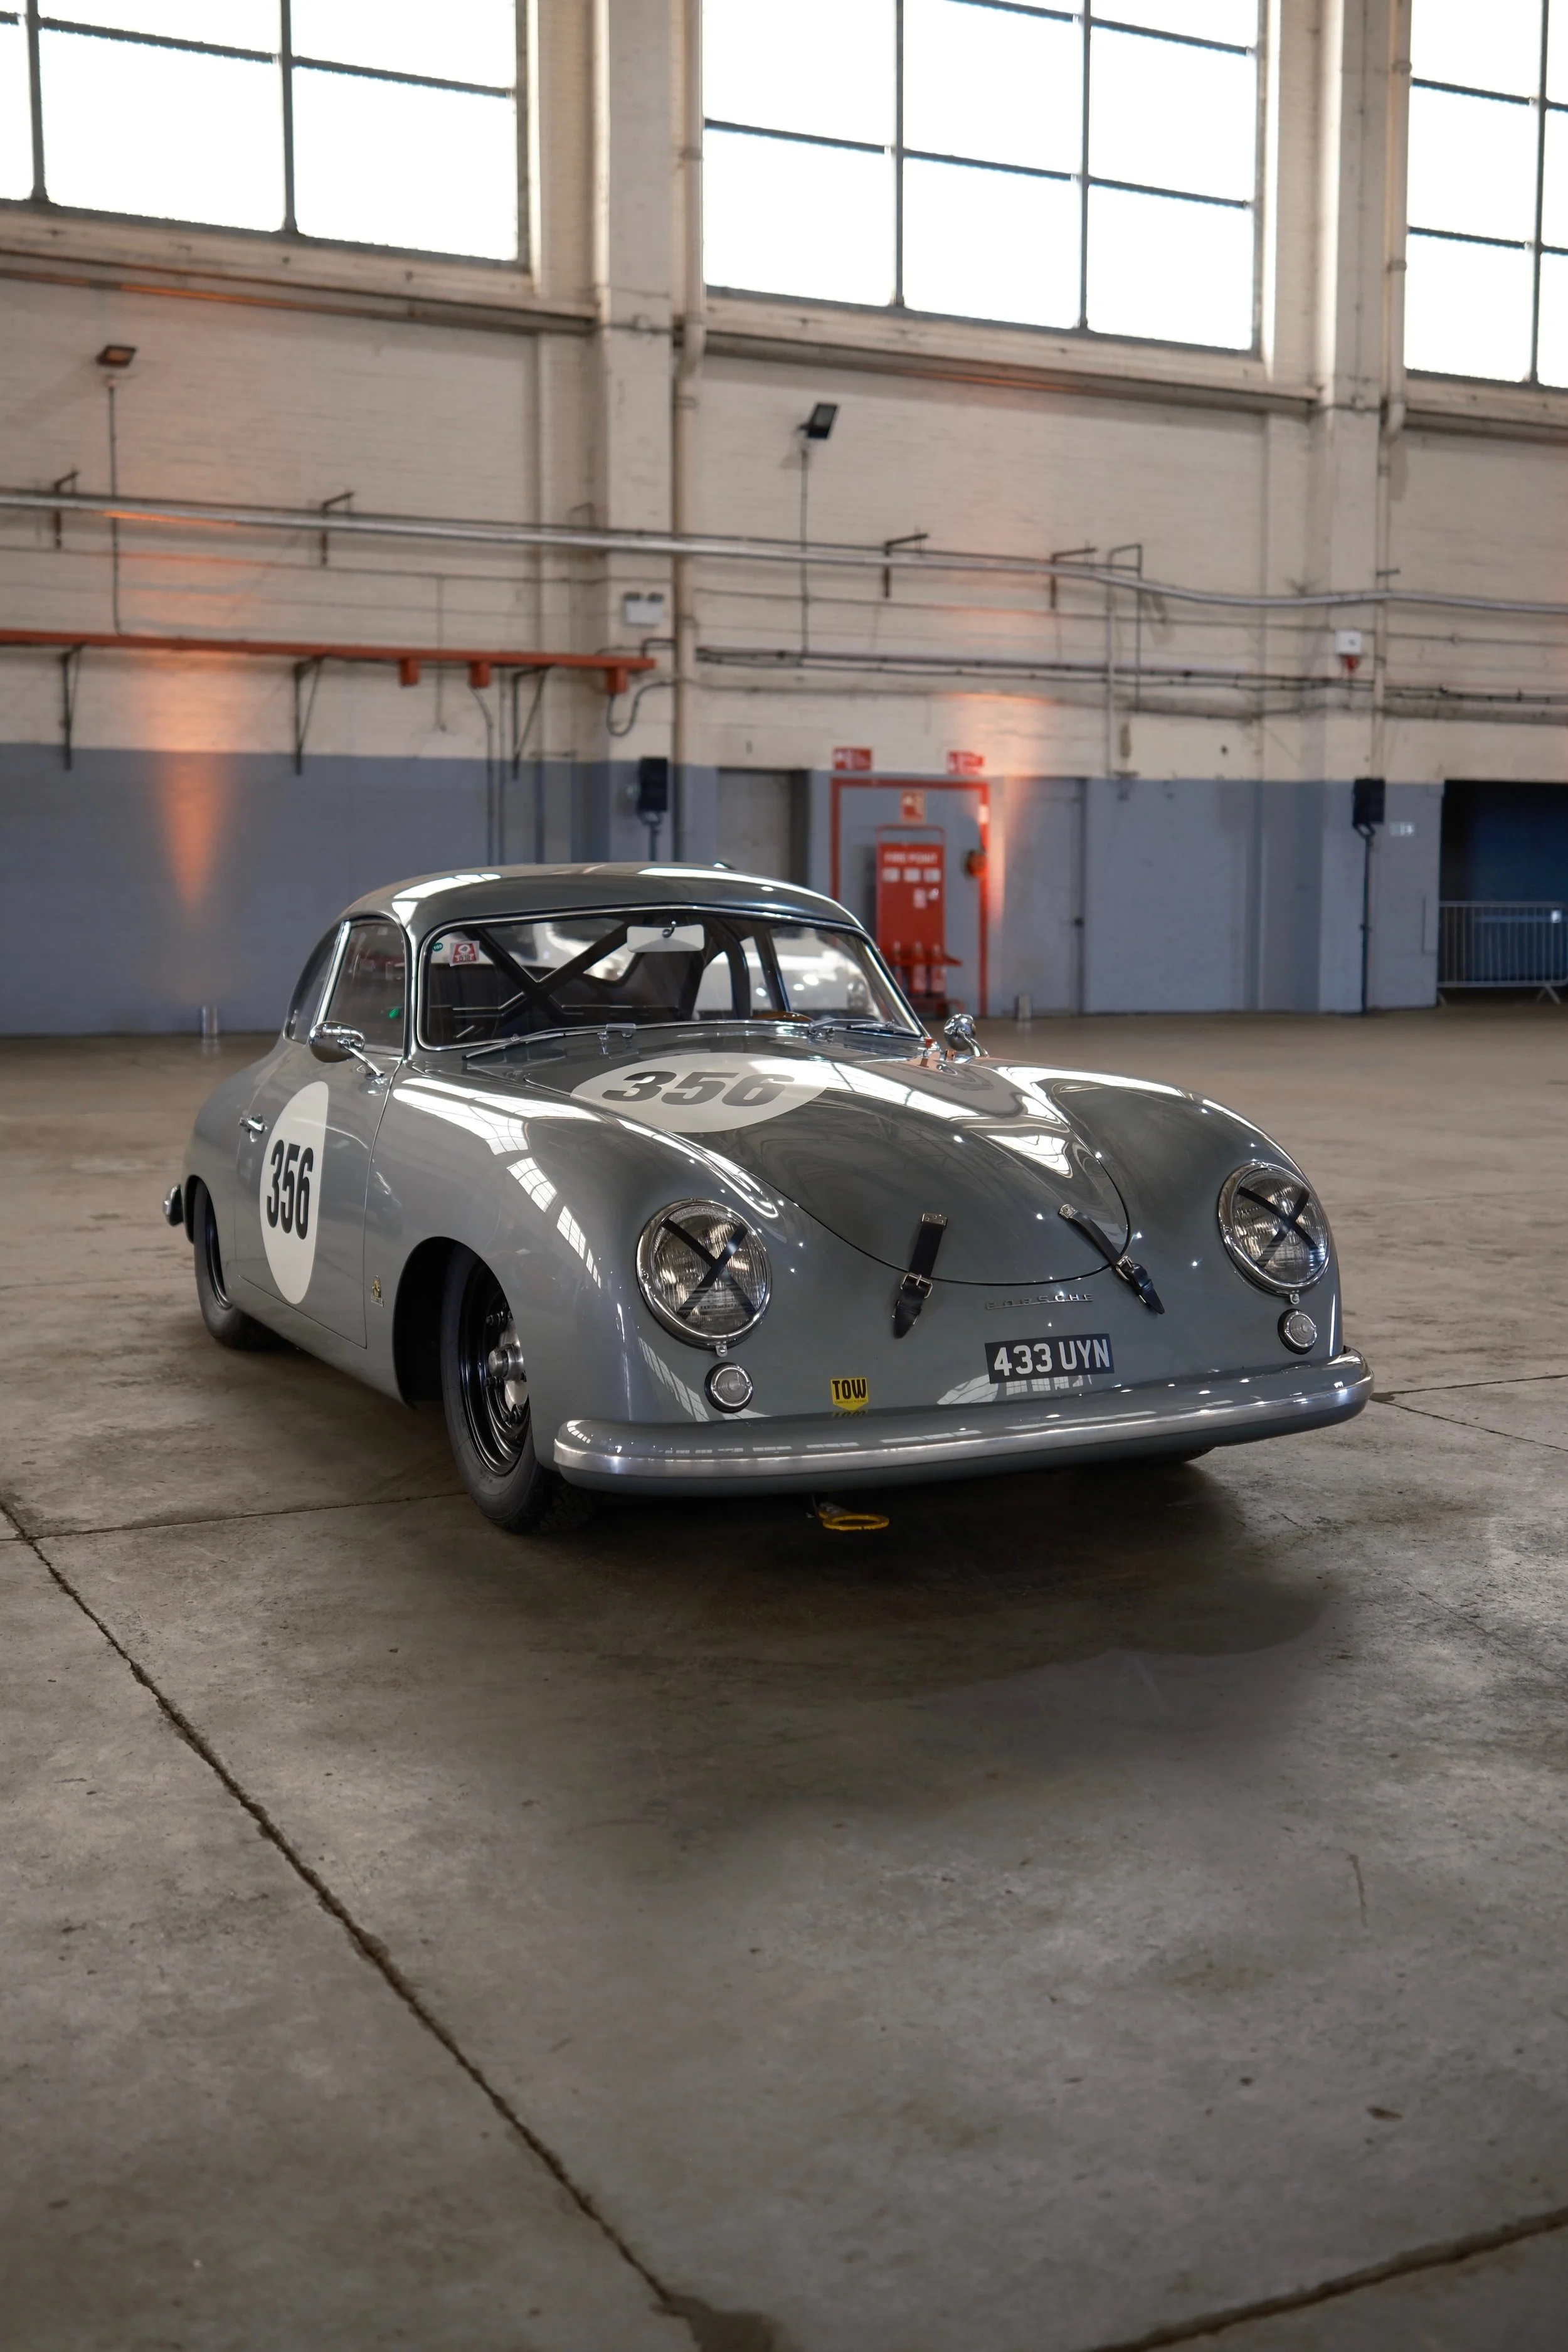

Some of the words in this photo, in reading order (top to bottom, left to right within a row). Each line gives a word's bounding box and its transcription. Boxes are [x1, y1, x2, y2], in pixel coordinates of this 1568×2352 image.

[601, 1071, 795, 1106] 356
[267, 1139, 314, 1240] 356
[985, 1294, 1093, 1310] PORSCHE
[993, 1343, 1052, 1377] 433
[1059, 1338, 1110, 1370] UYN
[832, 1379, 866, 1400] TOW
